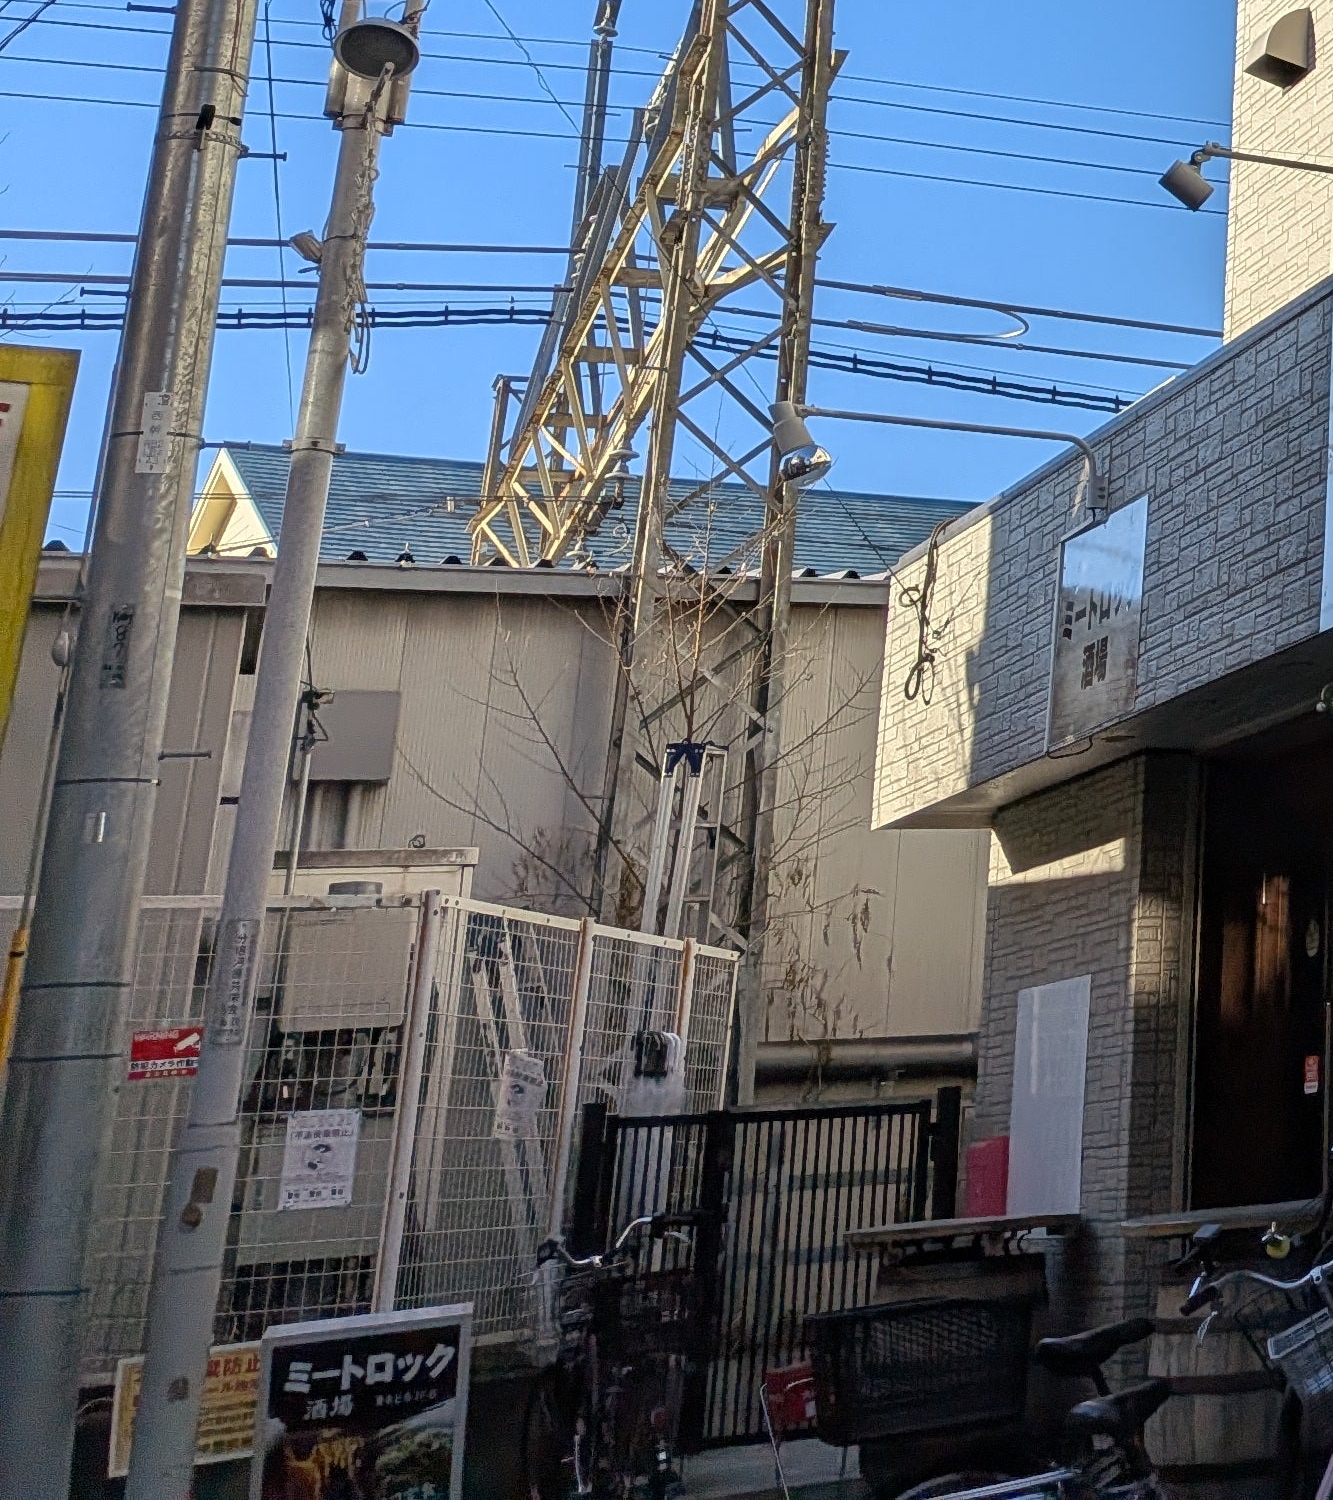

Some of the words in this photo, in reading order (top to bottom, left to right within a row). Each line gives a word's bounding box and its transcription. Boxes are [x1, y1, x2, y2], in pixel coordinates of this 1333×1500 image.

[283, 1343, 456, 1394] ミートロック
